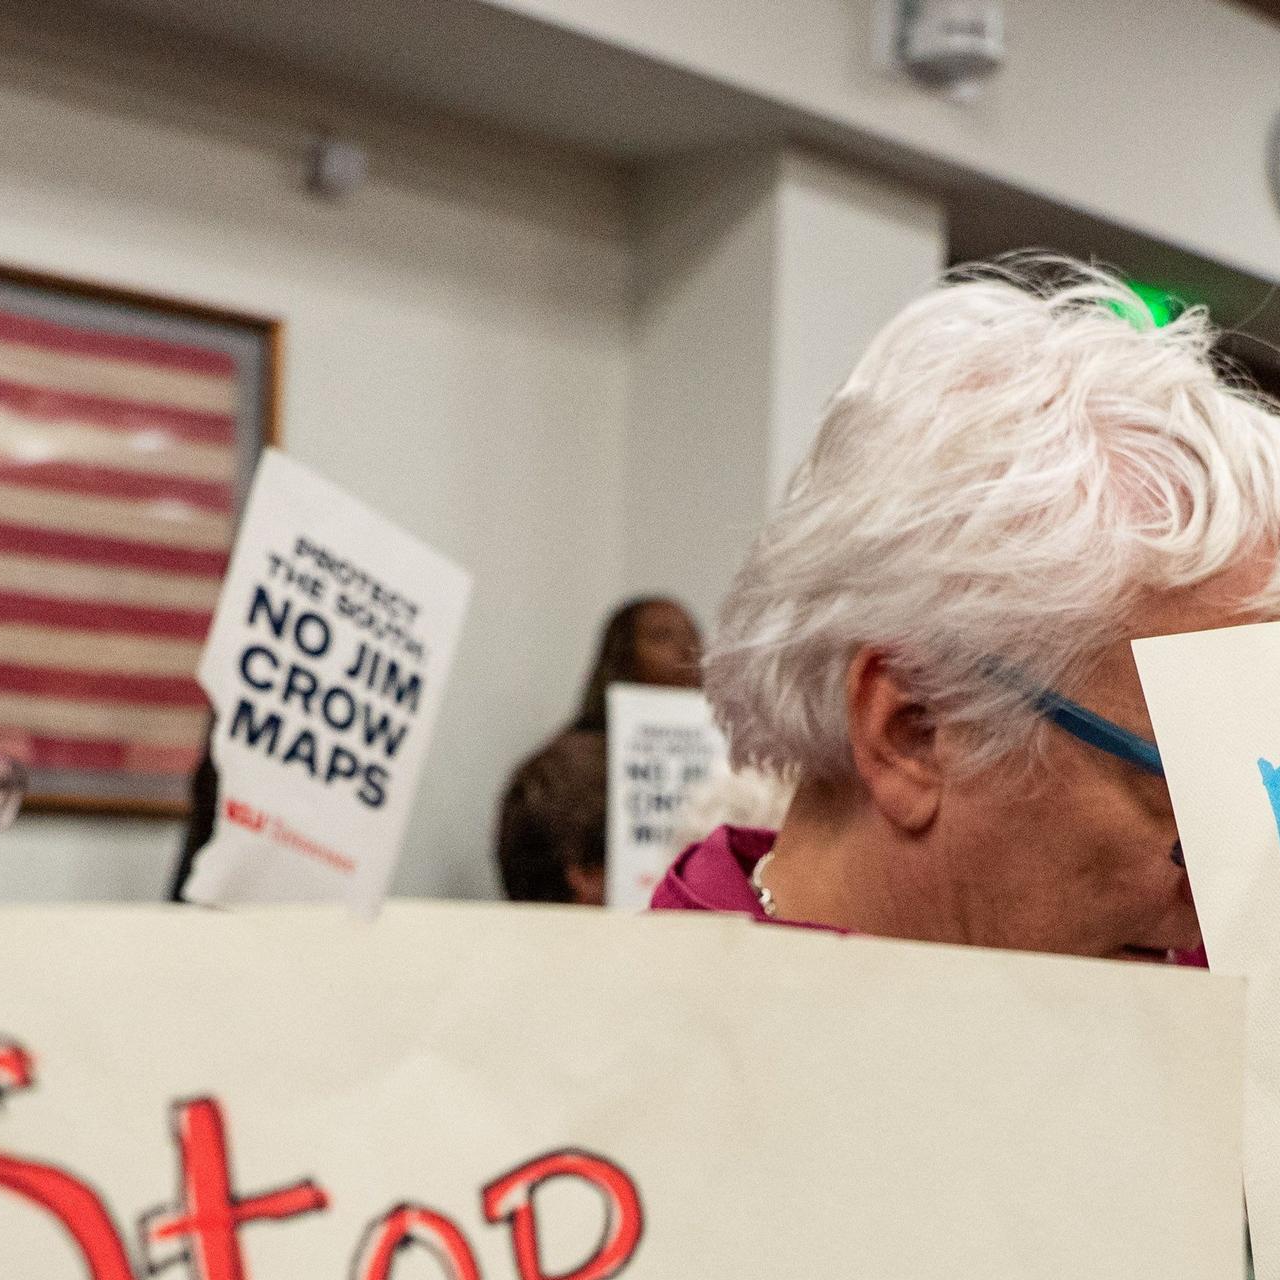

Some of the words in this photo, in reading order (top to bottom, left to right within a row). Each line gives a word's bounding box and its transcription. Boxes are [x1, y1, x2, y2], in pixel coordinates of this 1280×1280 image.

[269, 553, 326, 601] THE
[335, 594, 424, 660] SOUTH
[295, 537, 419, 621] PROTECT
[239, 645, 408, 757] CROW
[248, 585, 331, 658] NO
[345, 642, 421, 713] JIM
[230, 699, 390, 809] MAPS
